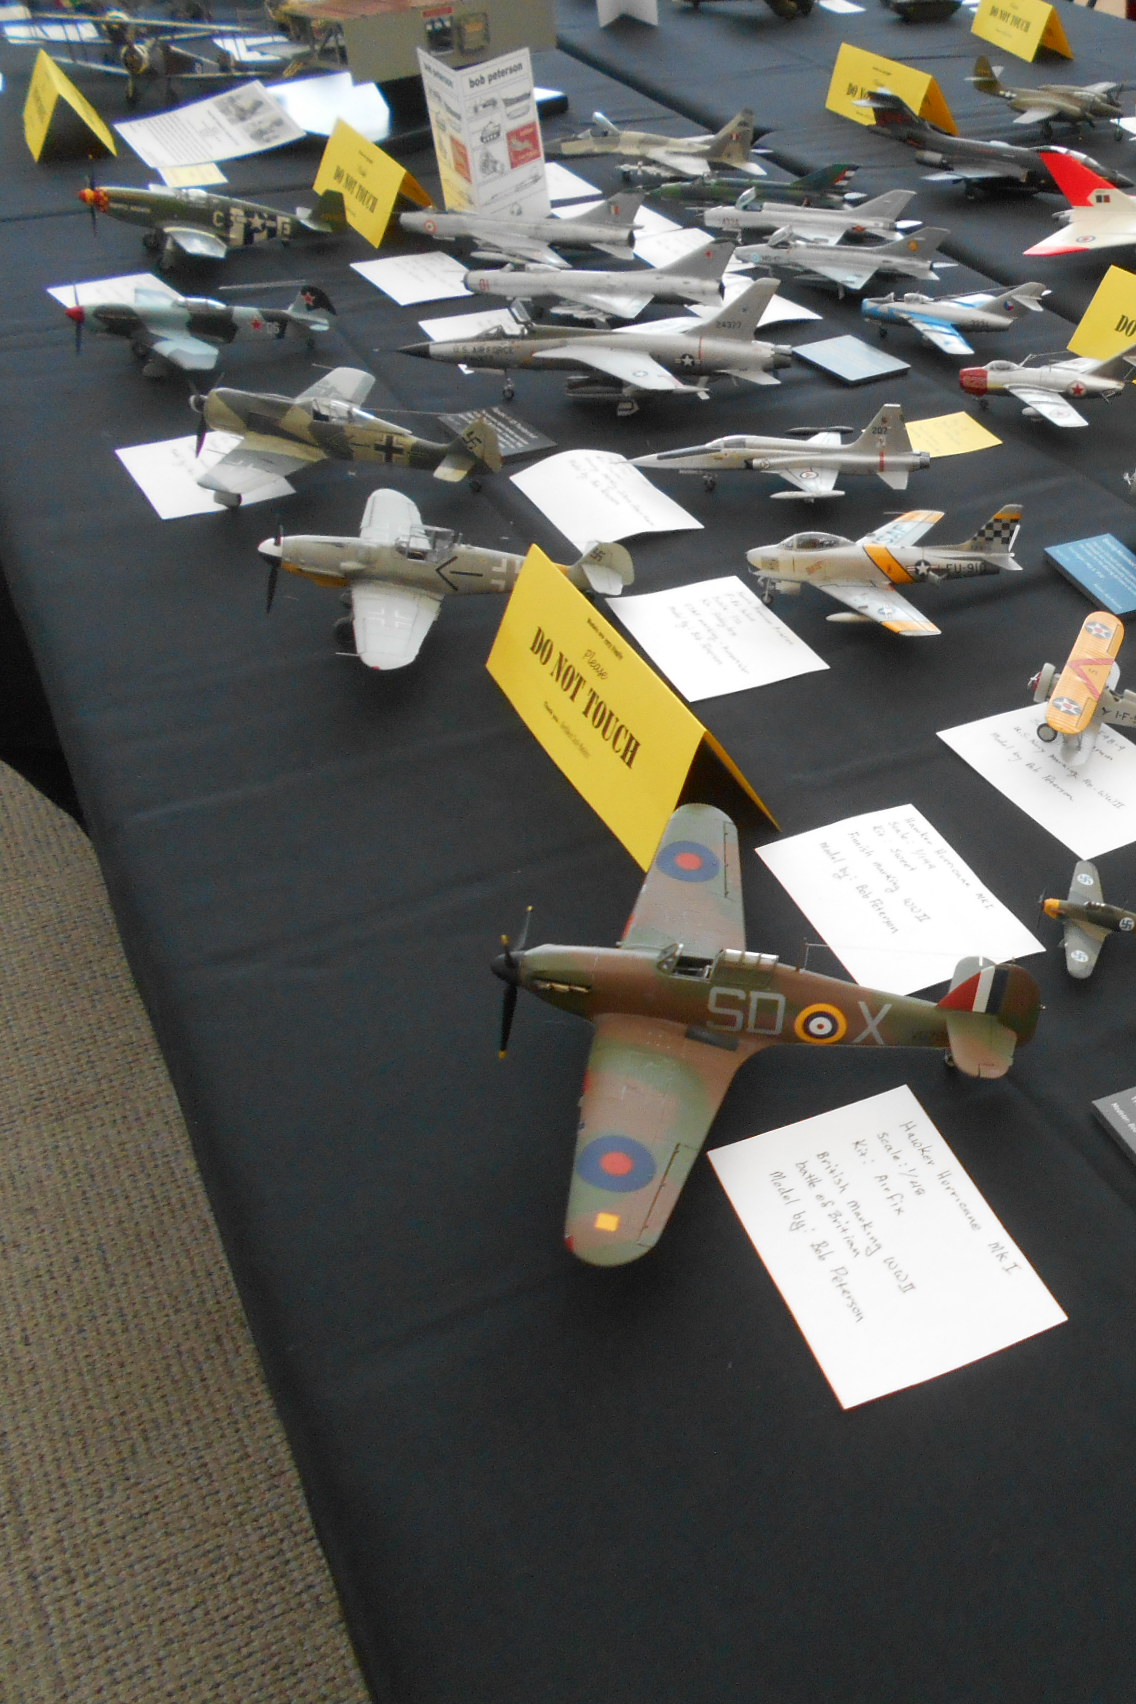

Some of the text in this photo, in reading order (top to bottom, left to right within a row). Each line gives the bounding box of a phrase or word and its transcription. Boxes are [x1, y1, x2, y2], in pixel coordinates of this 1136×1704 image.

[469, 62, 523, 89] bob peterson
[582, 649, 608, 680] Please
[530, 626, 554, 666] DO
[550, 651, 586, 703] NOT
[581, 687, 641, 769] TOUCH
[706, 986, 893, 1046] SD X
[816, 1151, 847, 1195] British
[900, 1120, 982, 1232] Hawker Hurricane
[769, 1170, 800, 1205] Model
[810, 1240, 834, 1262] Bob
[831, 1265, 864, 1323] Peterson
